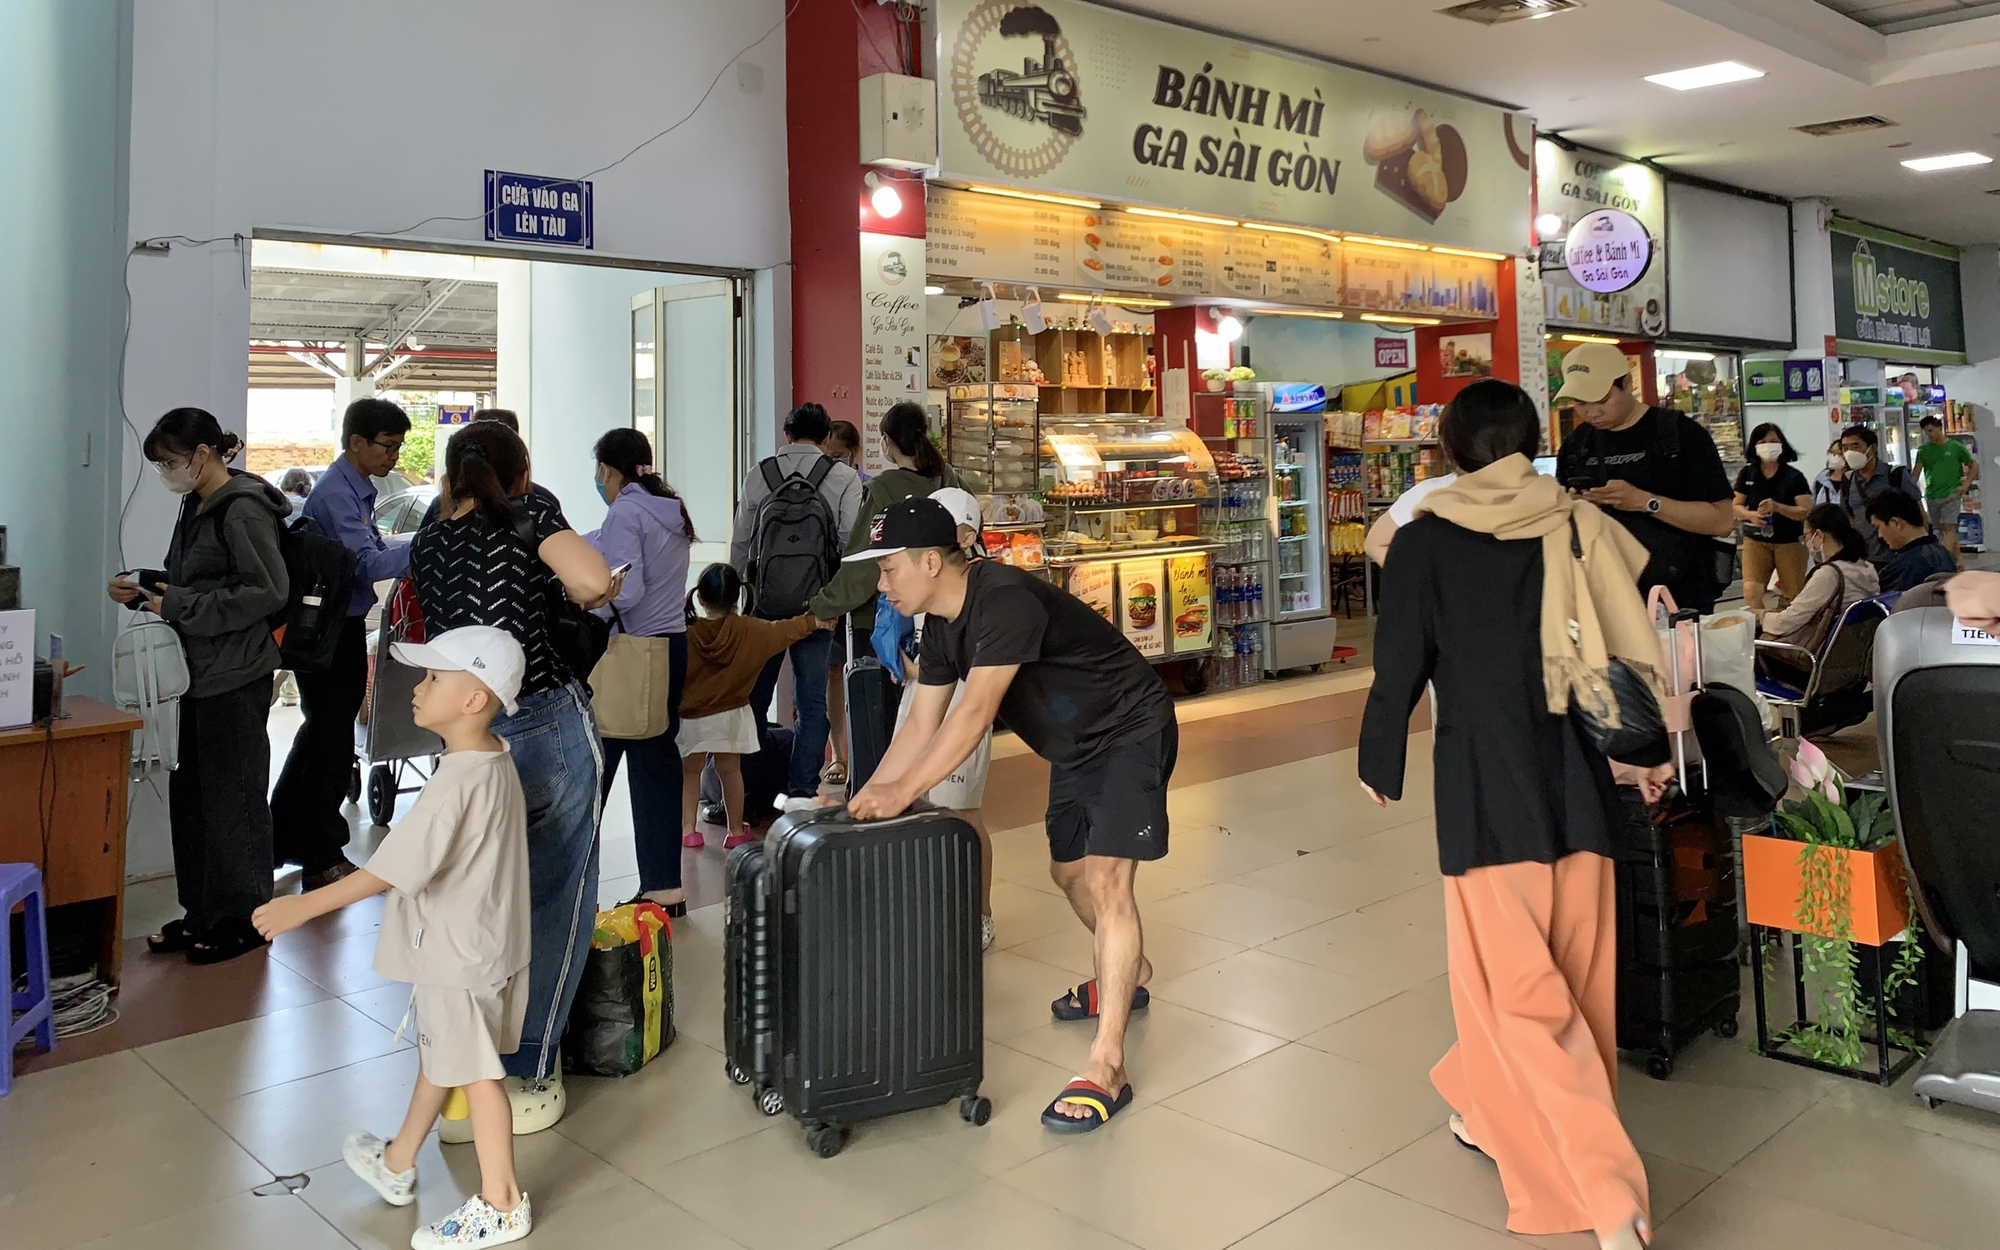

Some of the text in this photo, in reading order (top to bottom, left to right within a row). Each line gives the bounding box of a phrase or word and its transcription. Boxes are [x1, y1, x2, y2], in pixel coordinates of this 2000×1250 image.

[1152, 61, 1325, 137] BÁNH MÌ
[1133, 123, 1341, 195] GA SÀI GÒN
[502, 181, 579, 211] CỬA VÀO GA
[1561, 182, 1580, 199] GA
[515, 211, 566, 237] LÊN TÀU
[1605, 240, 1627, 261] Bánh
[1582, 269, 1594, 282] Ga
[866, 292, 919, 314] Coffee
[871, 315, 883, 335] Ga
[1378, 348, 1406, 364] OPEN
[1174, 563, 1195, 581] Bánh
